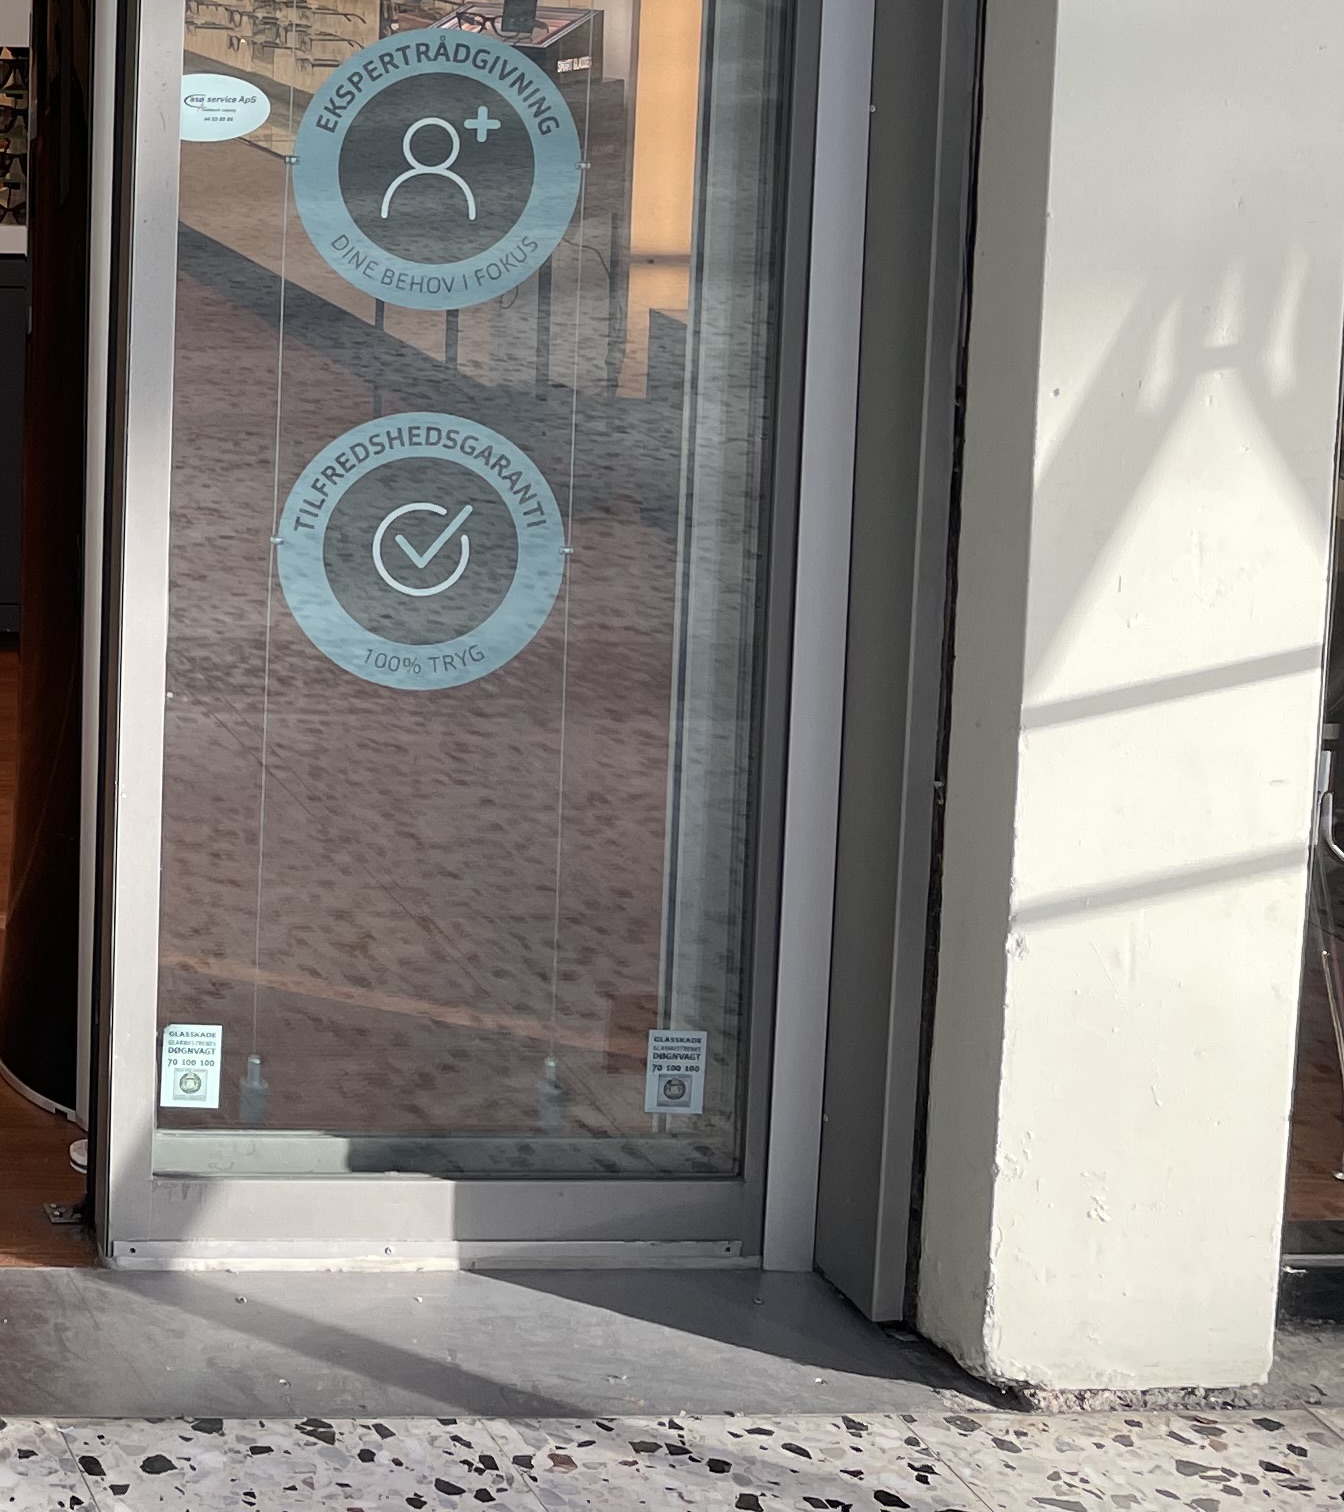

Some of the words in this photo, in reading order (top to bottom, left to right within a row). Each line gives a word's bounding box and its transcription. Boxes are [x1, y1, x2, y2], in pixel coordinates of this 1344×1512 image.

[207, 96, 237, 104] service
[238, 95, 257, 105] ApS
[316, 35, 560, 135] EKSPERTRÅDGIVNING
[330, 234, 379, 279] DINE
[380, 268, 455, 294] BEHOV
[463, 272, 469, 291] I
[474, 235, 539, 286] FOKUS
[293, 425, 547, 531] TILFREDSHEDSGARANTI
[363, 648, 421, 675] 100%
[428, 643, 485, 674] TRYG
